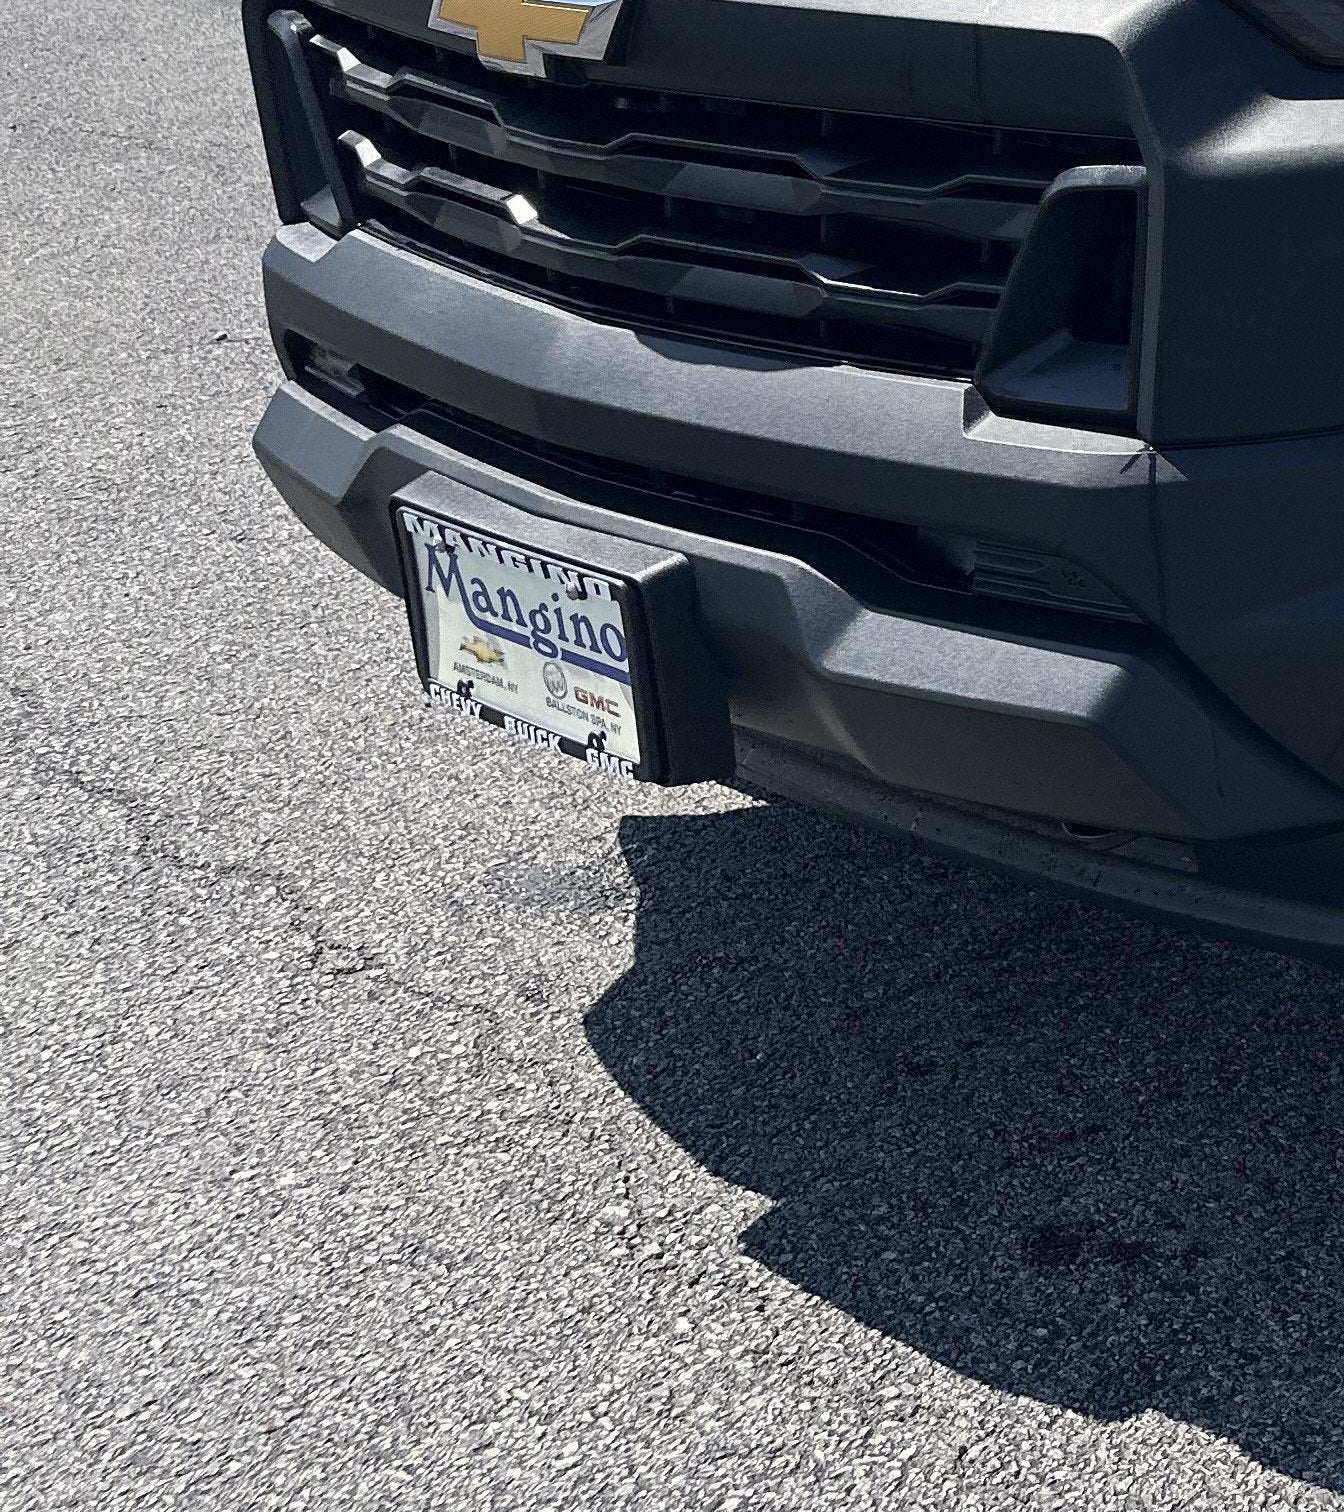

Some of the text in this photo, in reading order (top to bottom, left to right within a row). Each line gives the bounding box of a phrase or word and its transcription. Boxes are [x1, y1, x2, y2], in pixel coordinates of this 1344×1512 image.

[402, 511, 613, 603] MANGINO
[424, 541, 632, 668] Mangino
[429, 682, 635, 780] CHEVY BUICK GMC
[573, 686, 622, 719] GMC
